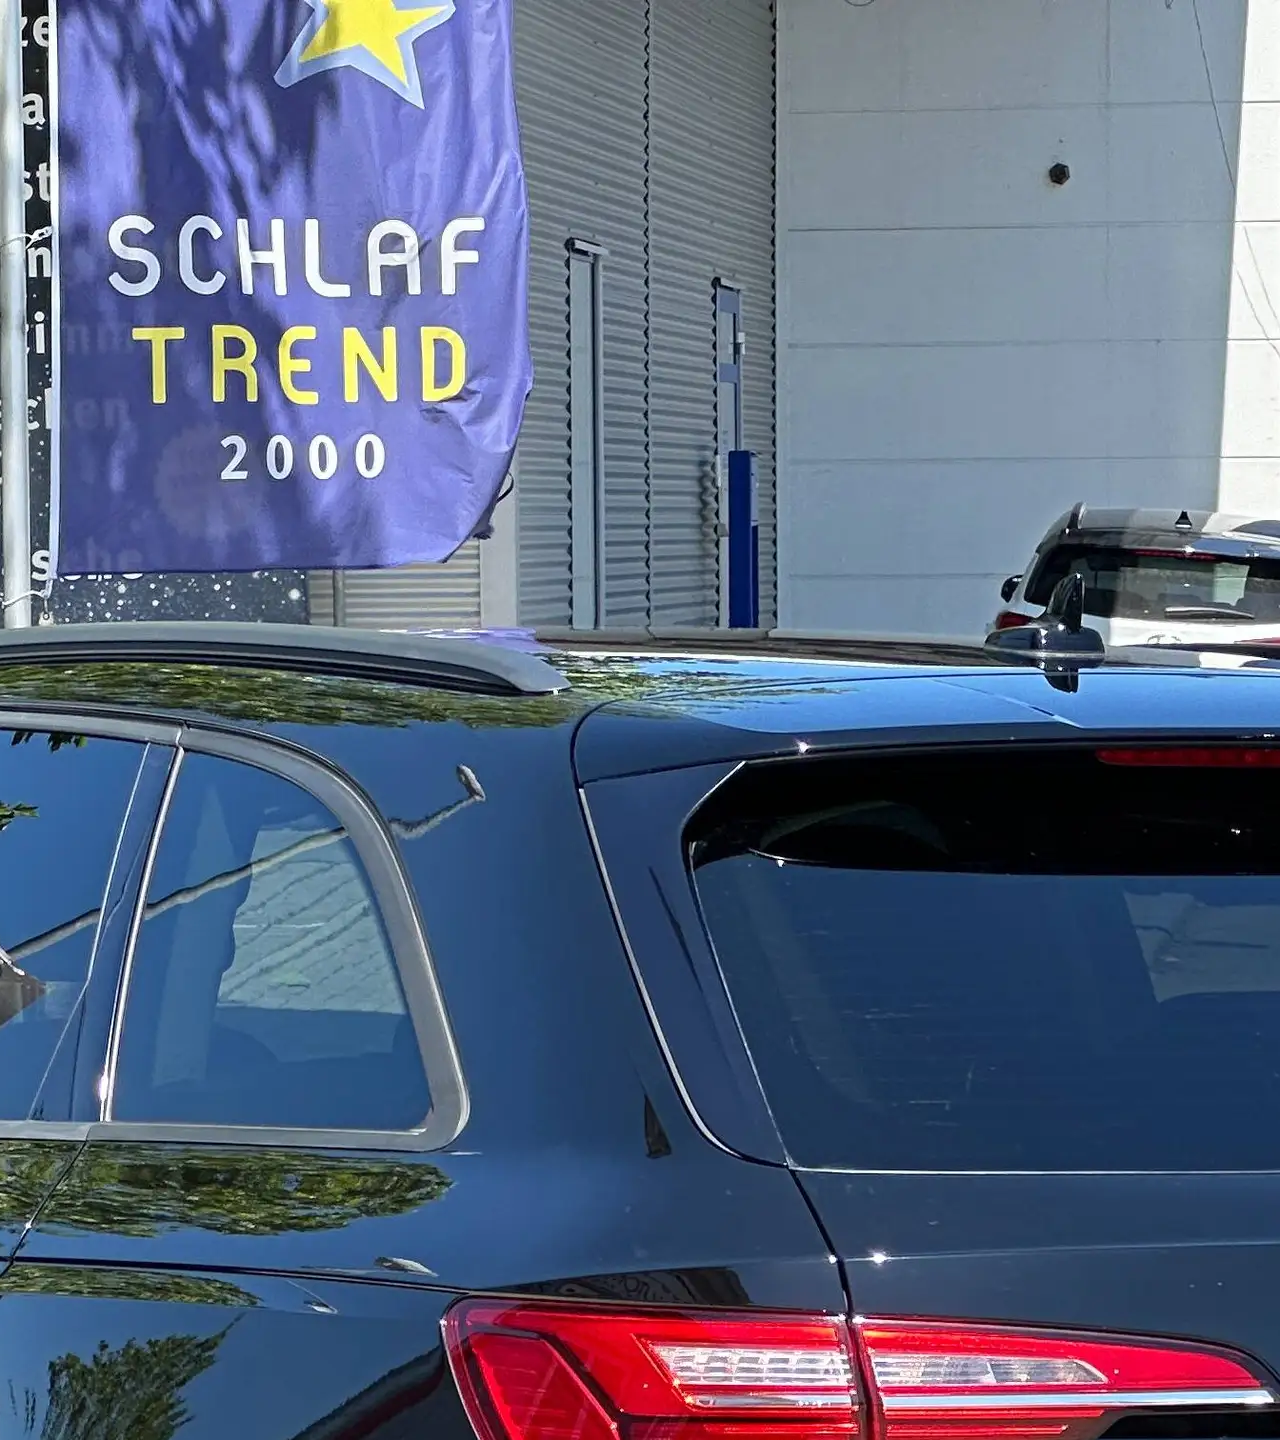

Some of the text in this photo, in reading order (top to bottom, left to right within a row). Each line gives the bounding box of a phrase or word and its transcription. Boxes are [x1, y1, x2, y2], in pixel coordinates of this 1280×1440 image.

[107, 214, 486, 298] SCHLAF
[132, 324, 467, 405] TREND
[220, 433, 386, 480] 2000
